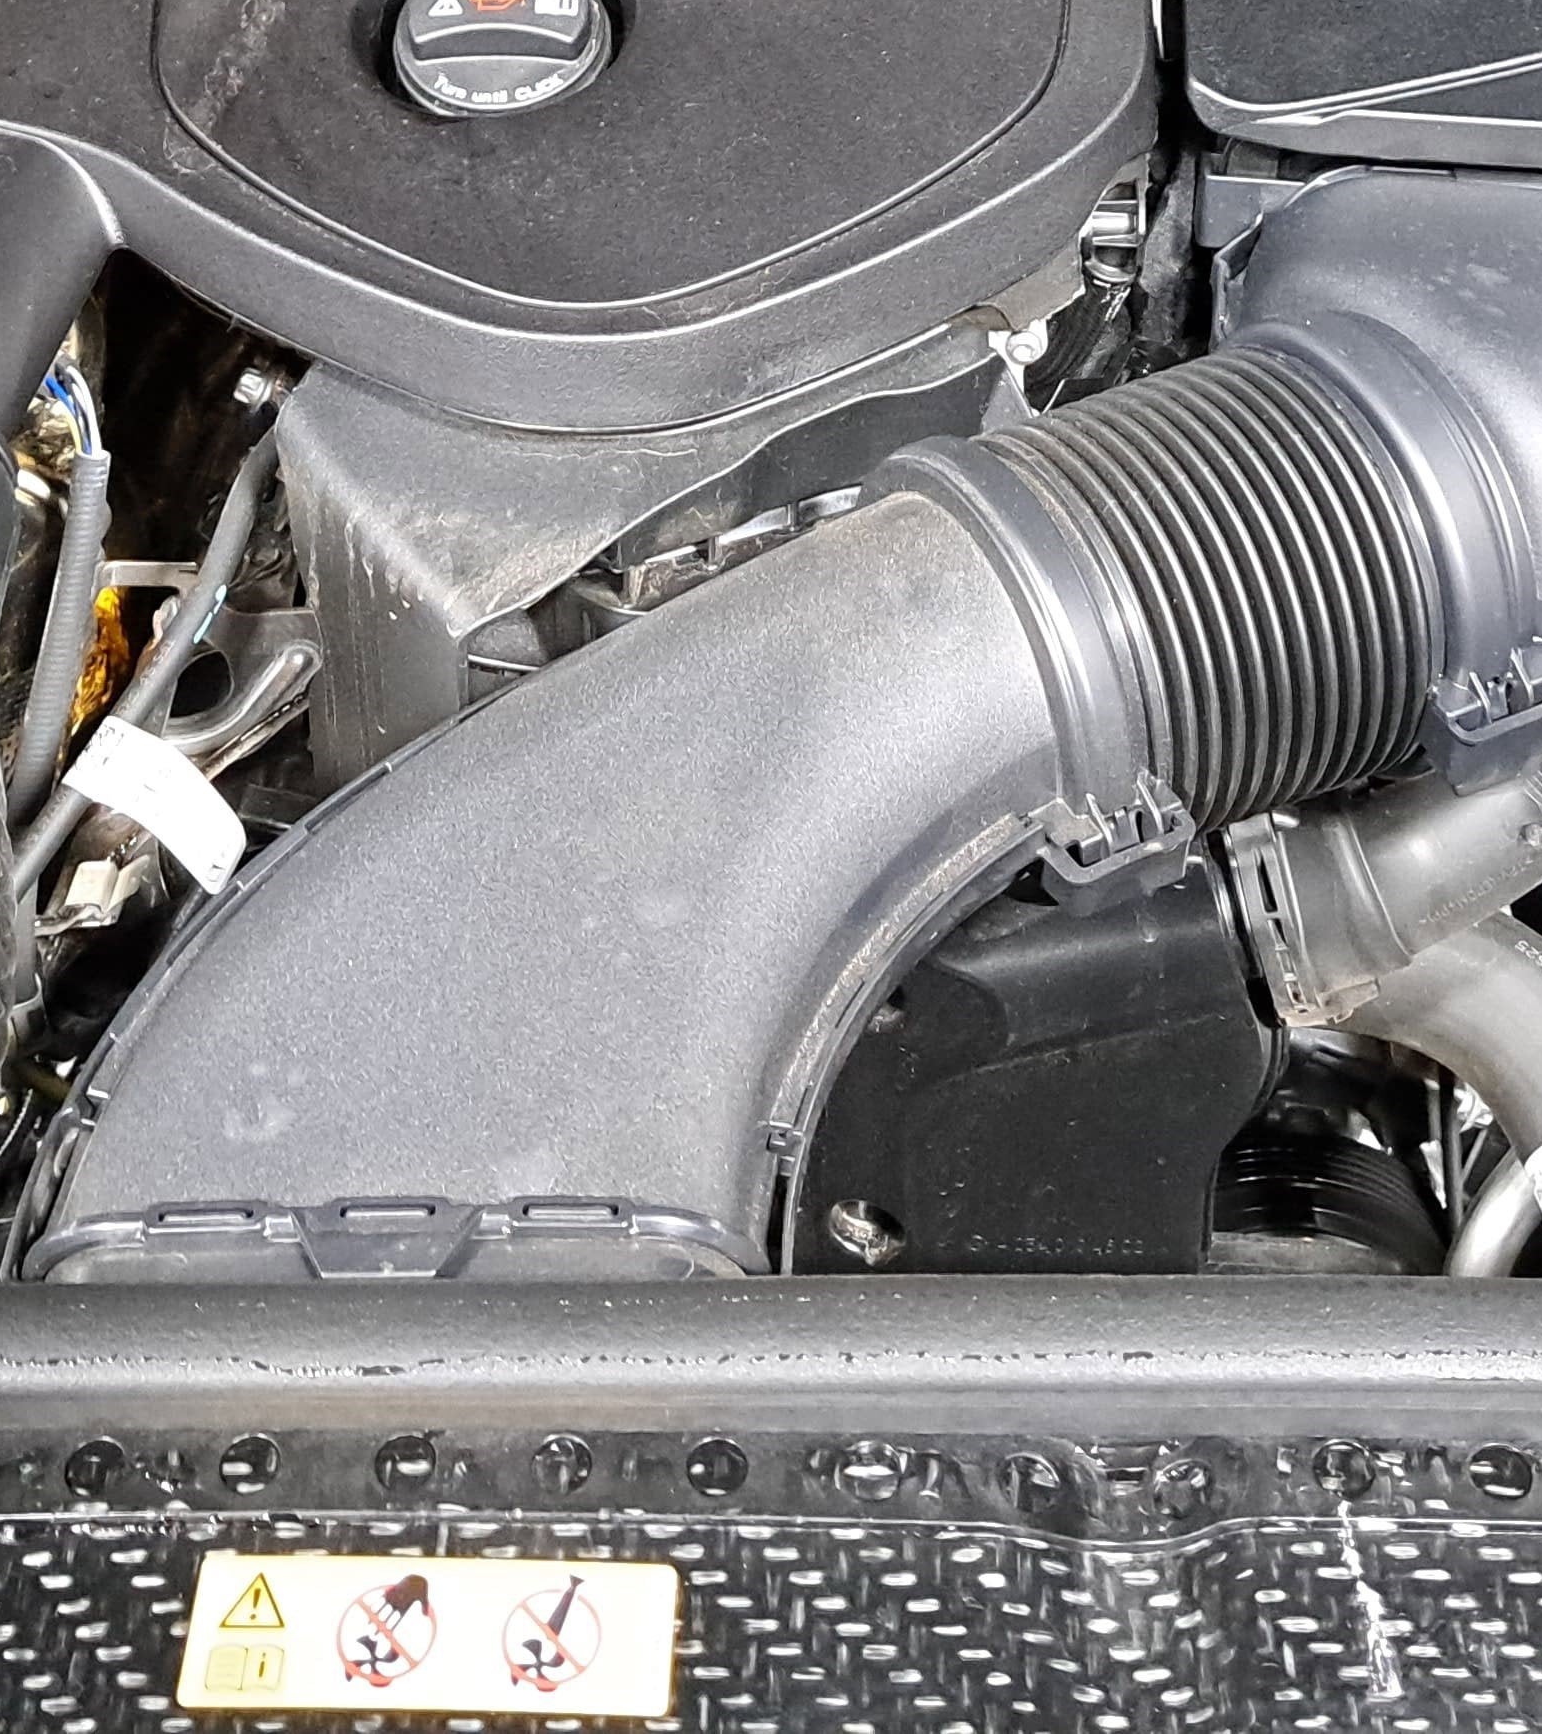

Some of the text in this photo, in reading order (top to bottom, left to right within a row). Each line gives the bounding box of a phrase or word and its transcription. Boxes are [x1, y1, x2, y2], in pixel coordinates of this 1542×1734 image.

[433, 72, 564, 103] Turn until CLICK
